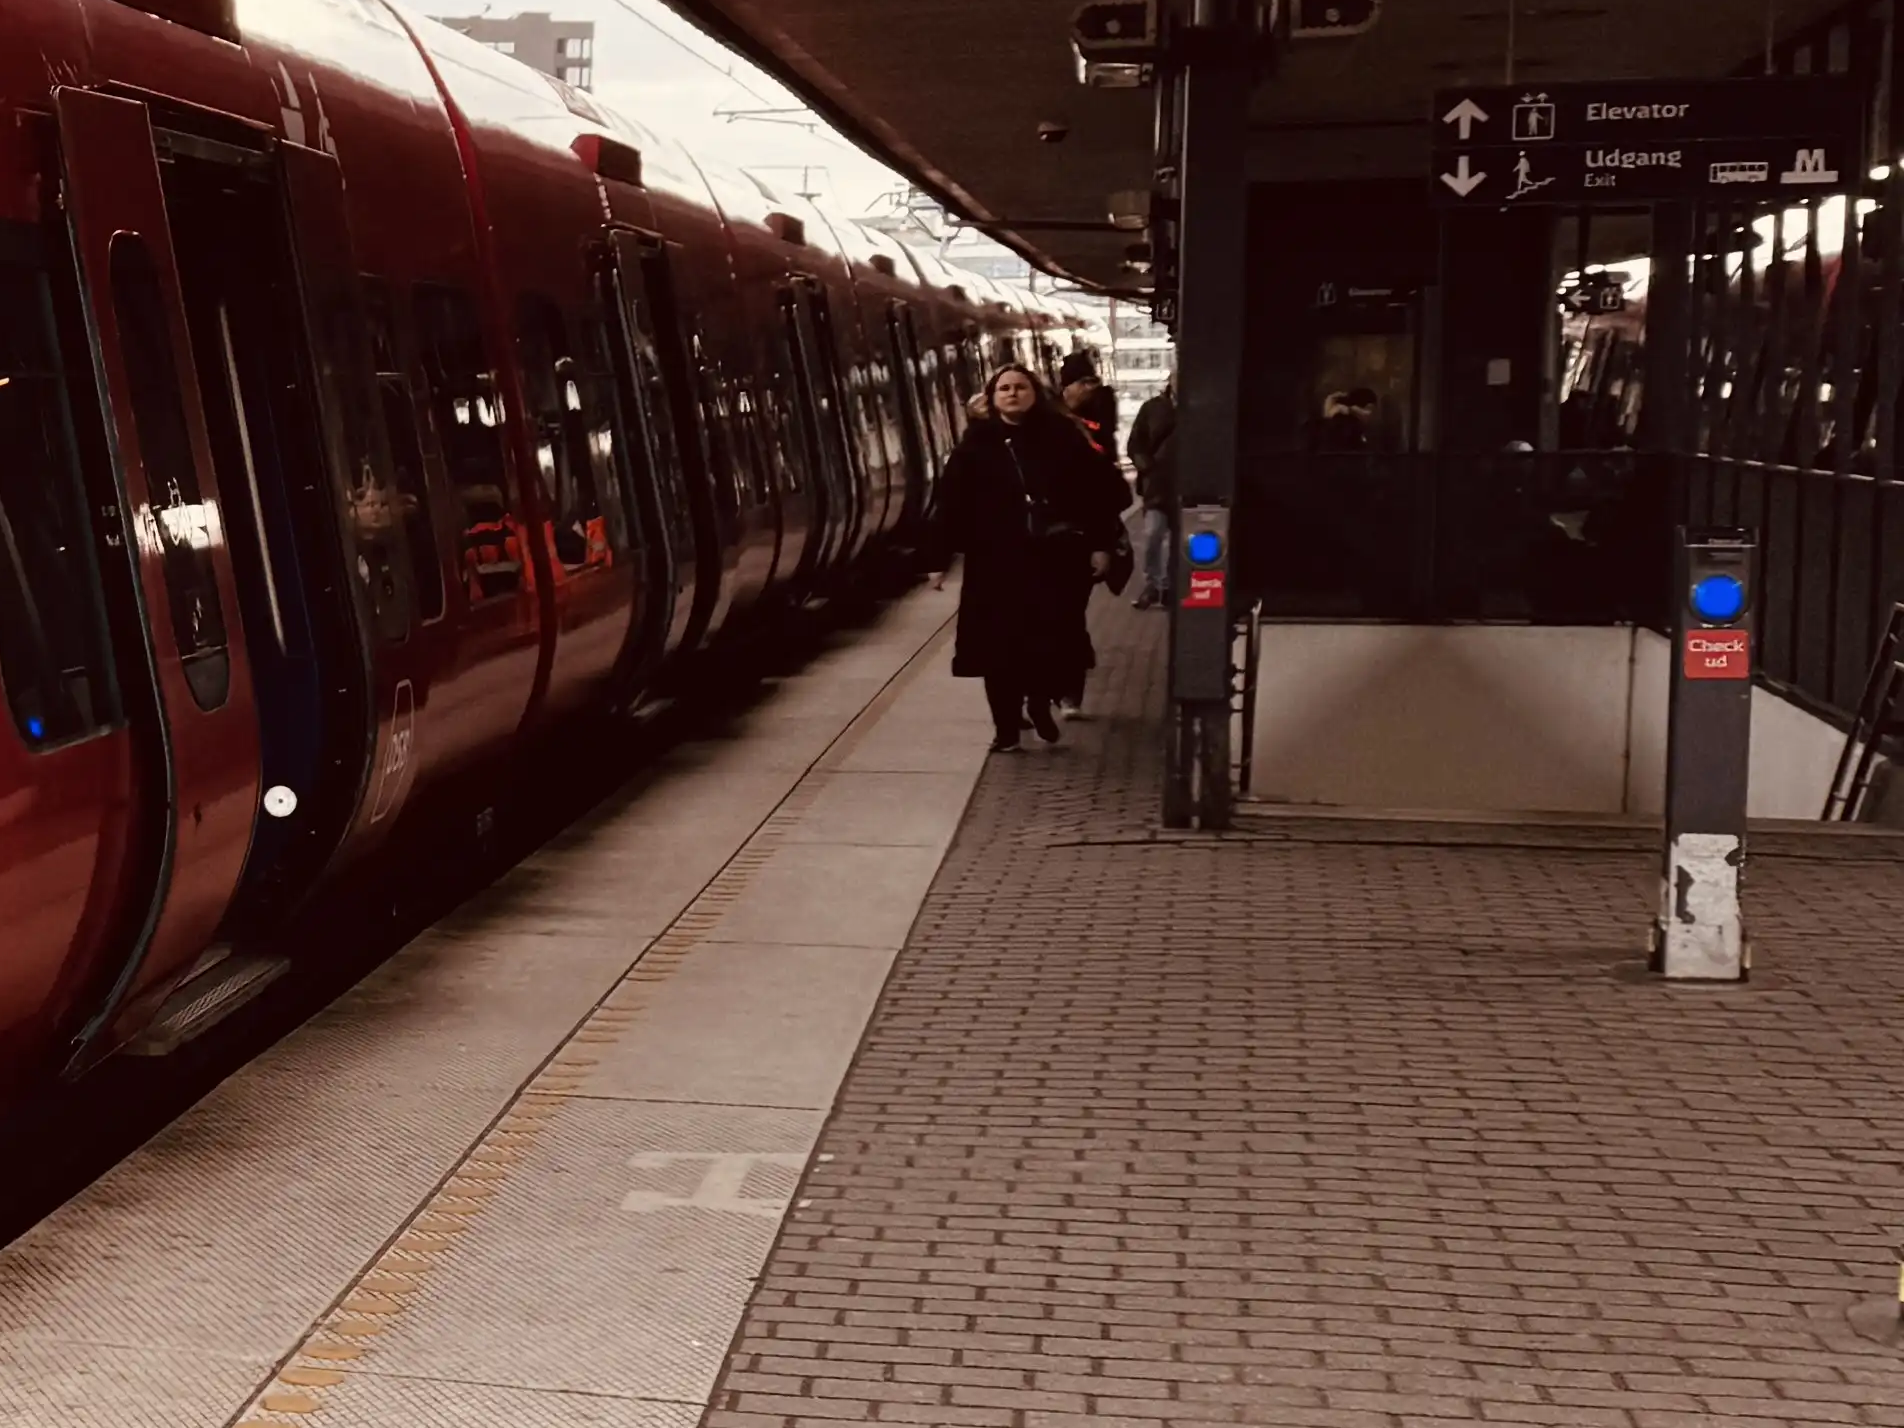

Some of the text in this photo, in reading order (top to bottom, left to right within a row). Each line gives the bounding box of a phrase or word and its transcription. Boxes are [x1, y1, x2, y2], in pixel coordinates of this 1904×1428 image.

[1586, 102, 1690, 121] Elevator
[1585, 148, 1682, 169] Udgang
[1584, 172, 1616, 188] Exit
[1688, 639, 1745, 653] Check
[1704, 655, 1728, 668] ud
